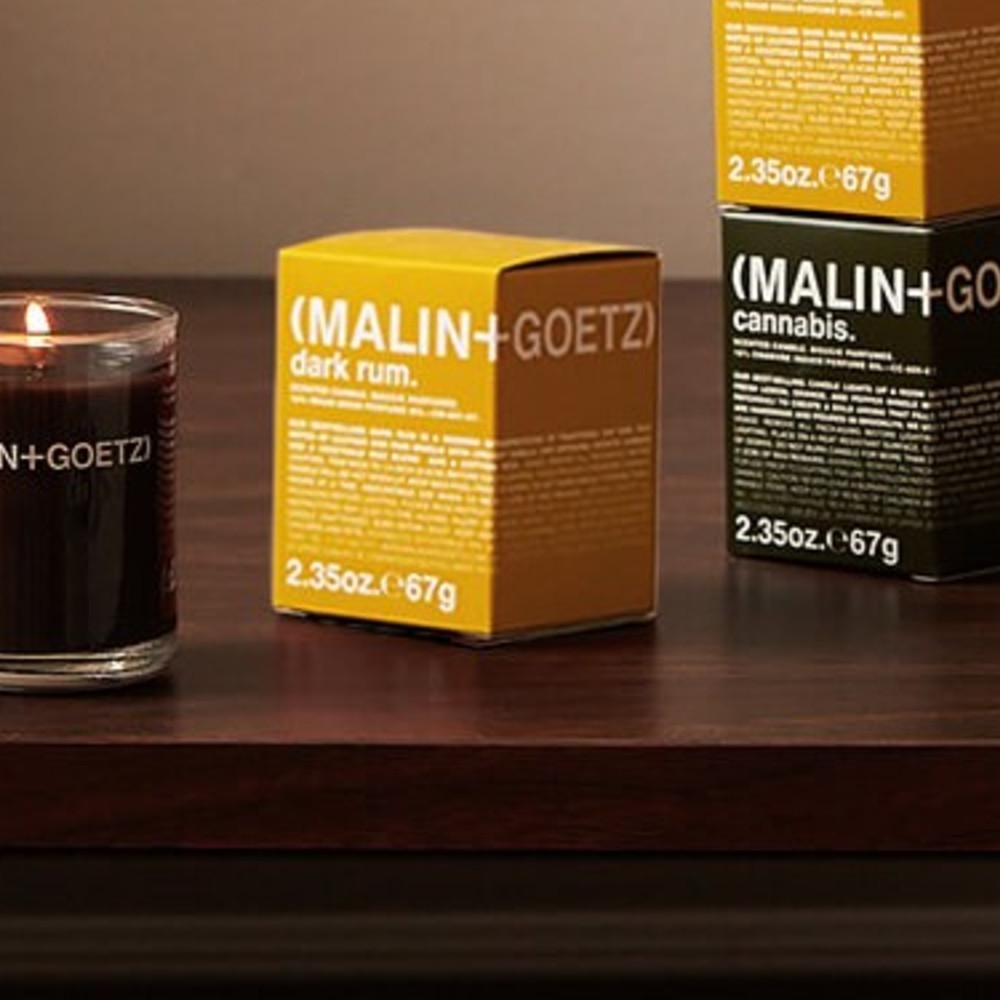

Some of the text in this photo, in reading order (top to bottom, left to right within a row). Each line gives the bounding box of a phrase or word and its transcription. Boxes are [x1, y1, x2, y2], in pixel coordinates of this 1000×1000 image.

[733, 309, 856, 342] cannabis.
[290, 349, 418, 387] dark rum.
